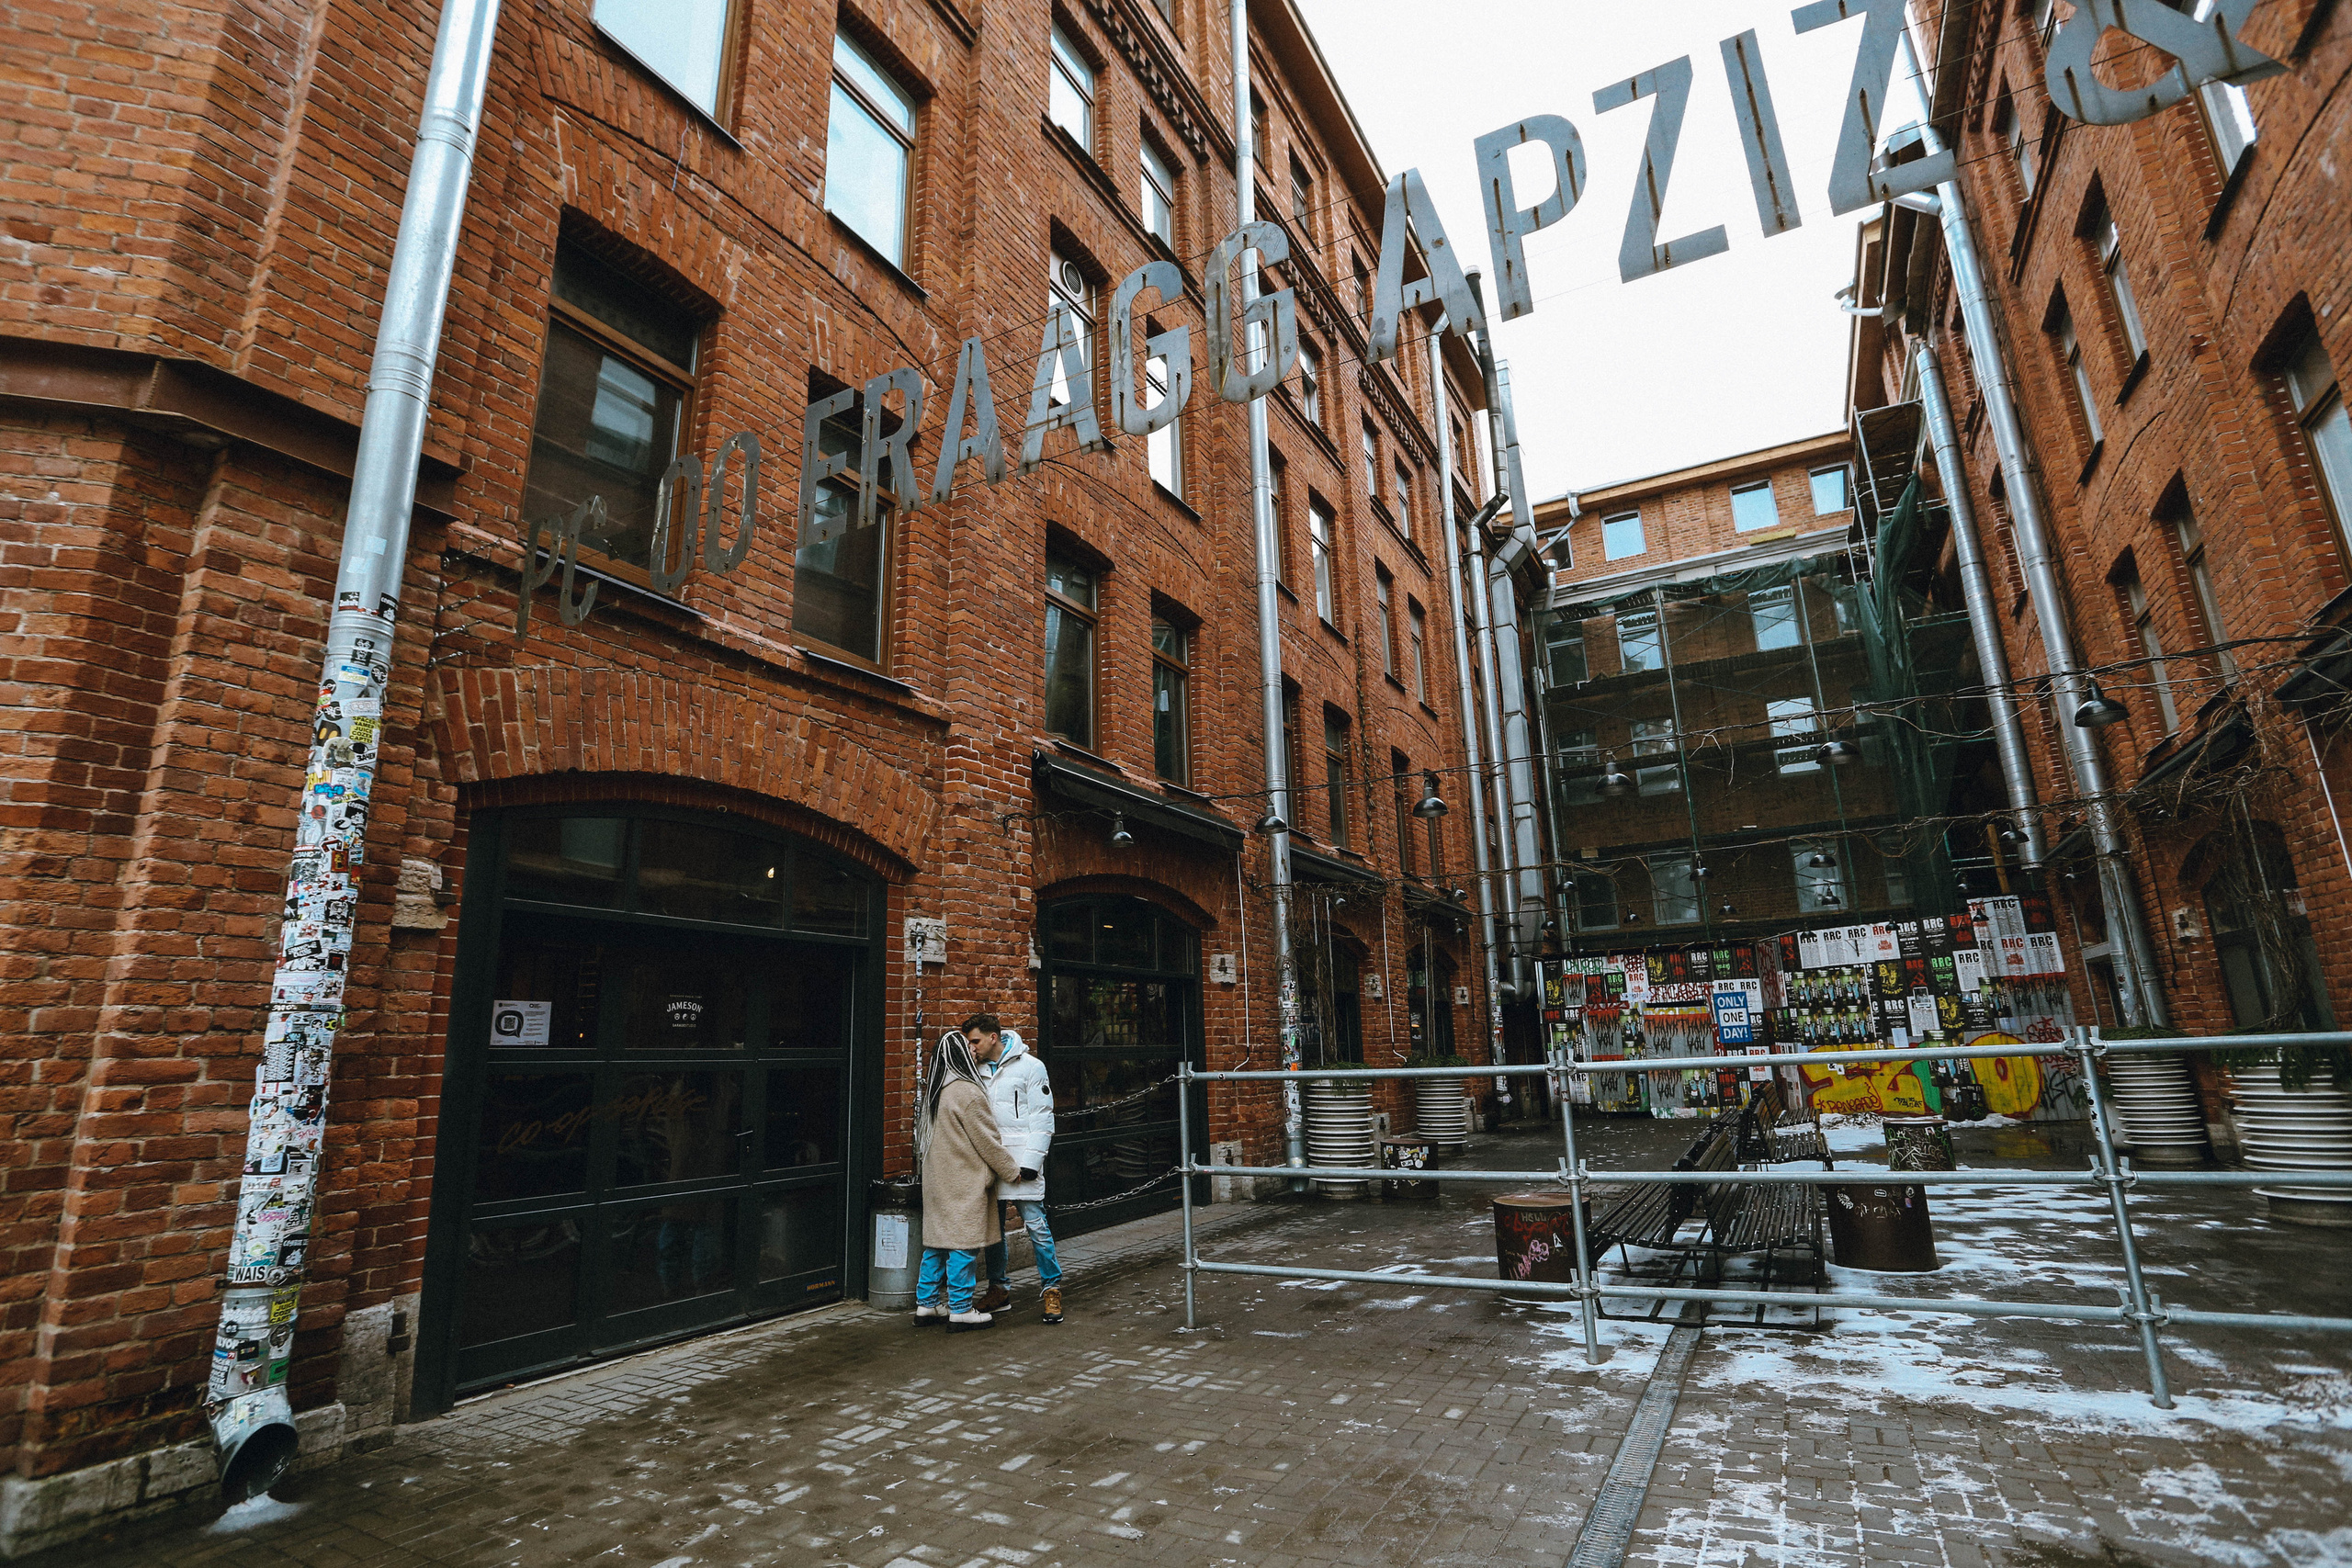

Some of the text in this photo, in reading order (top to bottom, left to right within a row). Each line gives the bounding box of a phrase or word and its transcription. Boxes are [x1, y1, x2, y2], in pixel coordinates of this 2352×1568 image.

[1994, 899, 2016, 909] RRC
[1923, 918, 1944, 930] RRC
[1823, 931, 1841, 942] RRC
[1848, 928, 1866, 938] RRC
[2001, 938, 2024, 949] RRC
[2030, 936, 2053, 947] RRC
[1690, 952, 1707, 962] RRC
[1713, 950, 1729, 959] RRC
[1959, 953, 1980, 964] RRC
[1905, 959, 1924, 969] RRC
[1931, 957, 1952, 967] RRC
[1608, 975, 1623, 983] RRC
[1629, 974, 1644, 982] RRC
[1718, 982, 1734, 990] RRC
[1740, 981, 1757, 990] RRC
[666, 1001, 703, 1012] JAMESON
[1717, 996, 1746, 1008] ONLY
[1884, 999, 1905, 1010] RRC
[1565, 1010, 1579, 1019] RRC
[1723, 1012, 1745, 1022] ONE
[1724, 1028, 1748, 1039] DAY!
